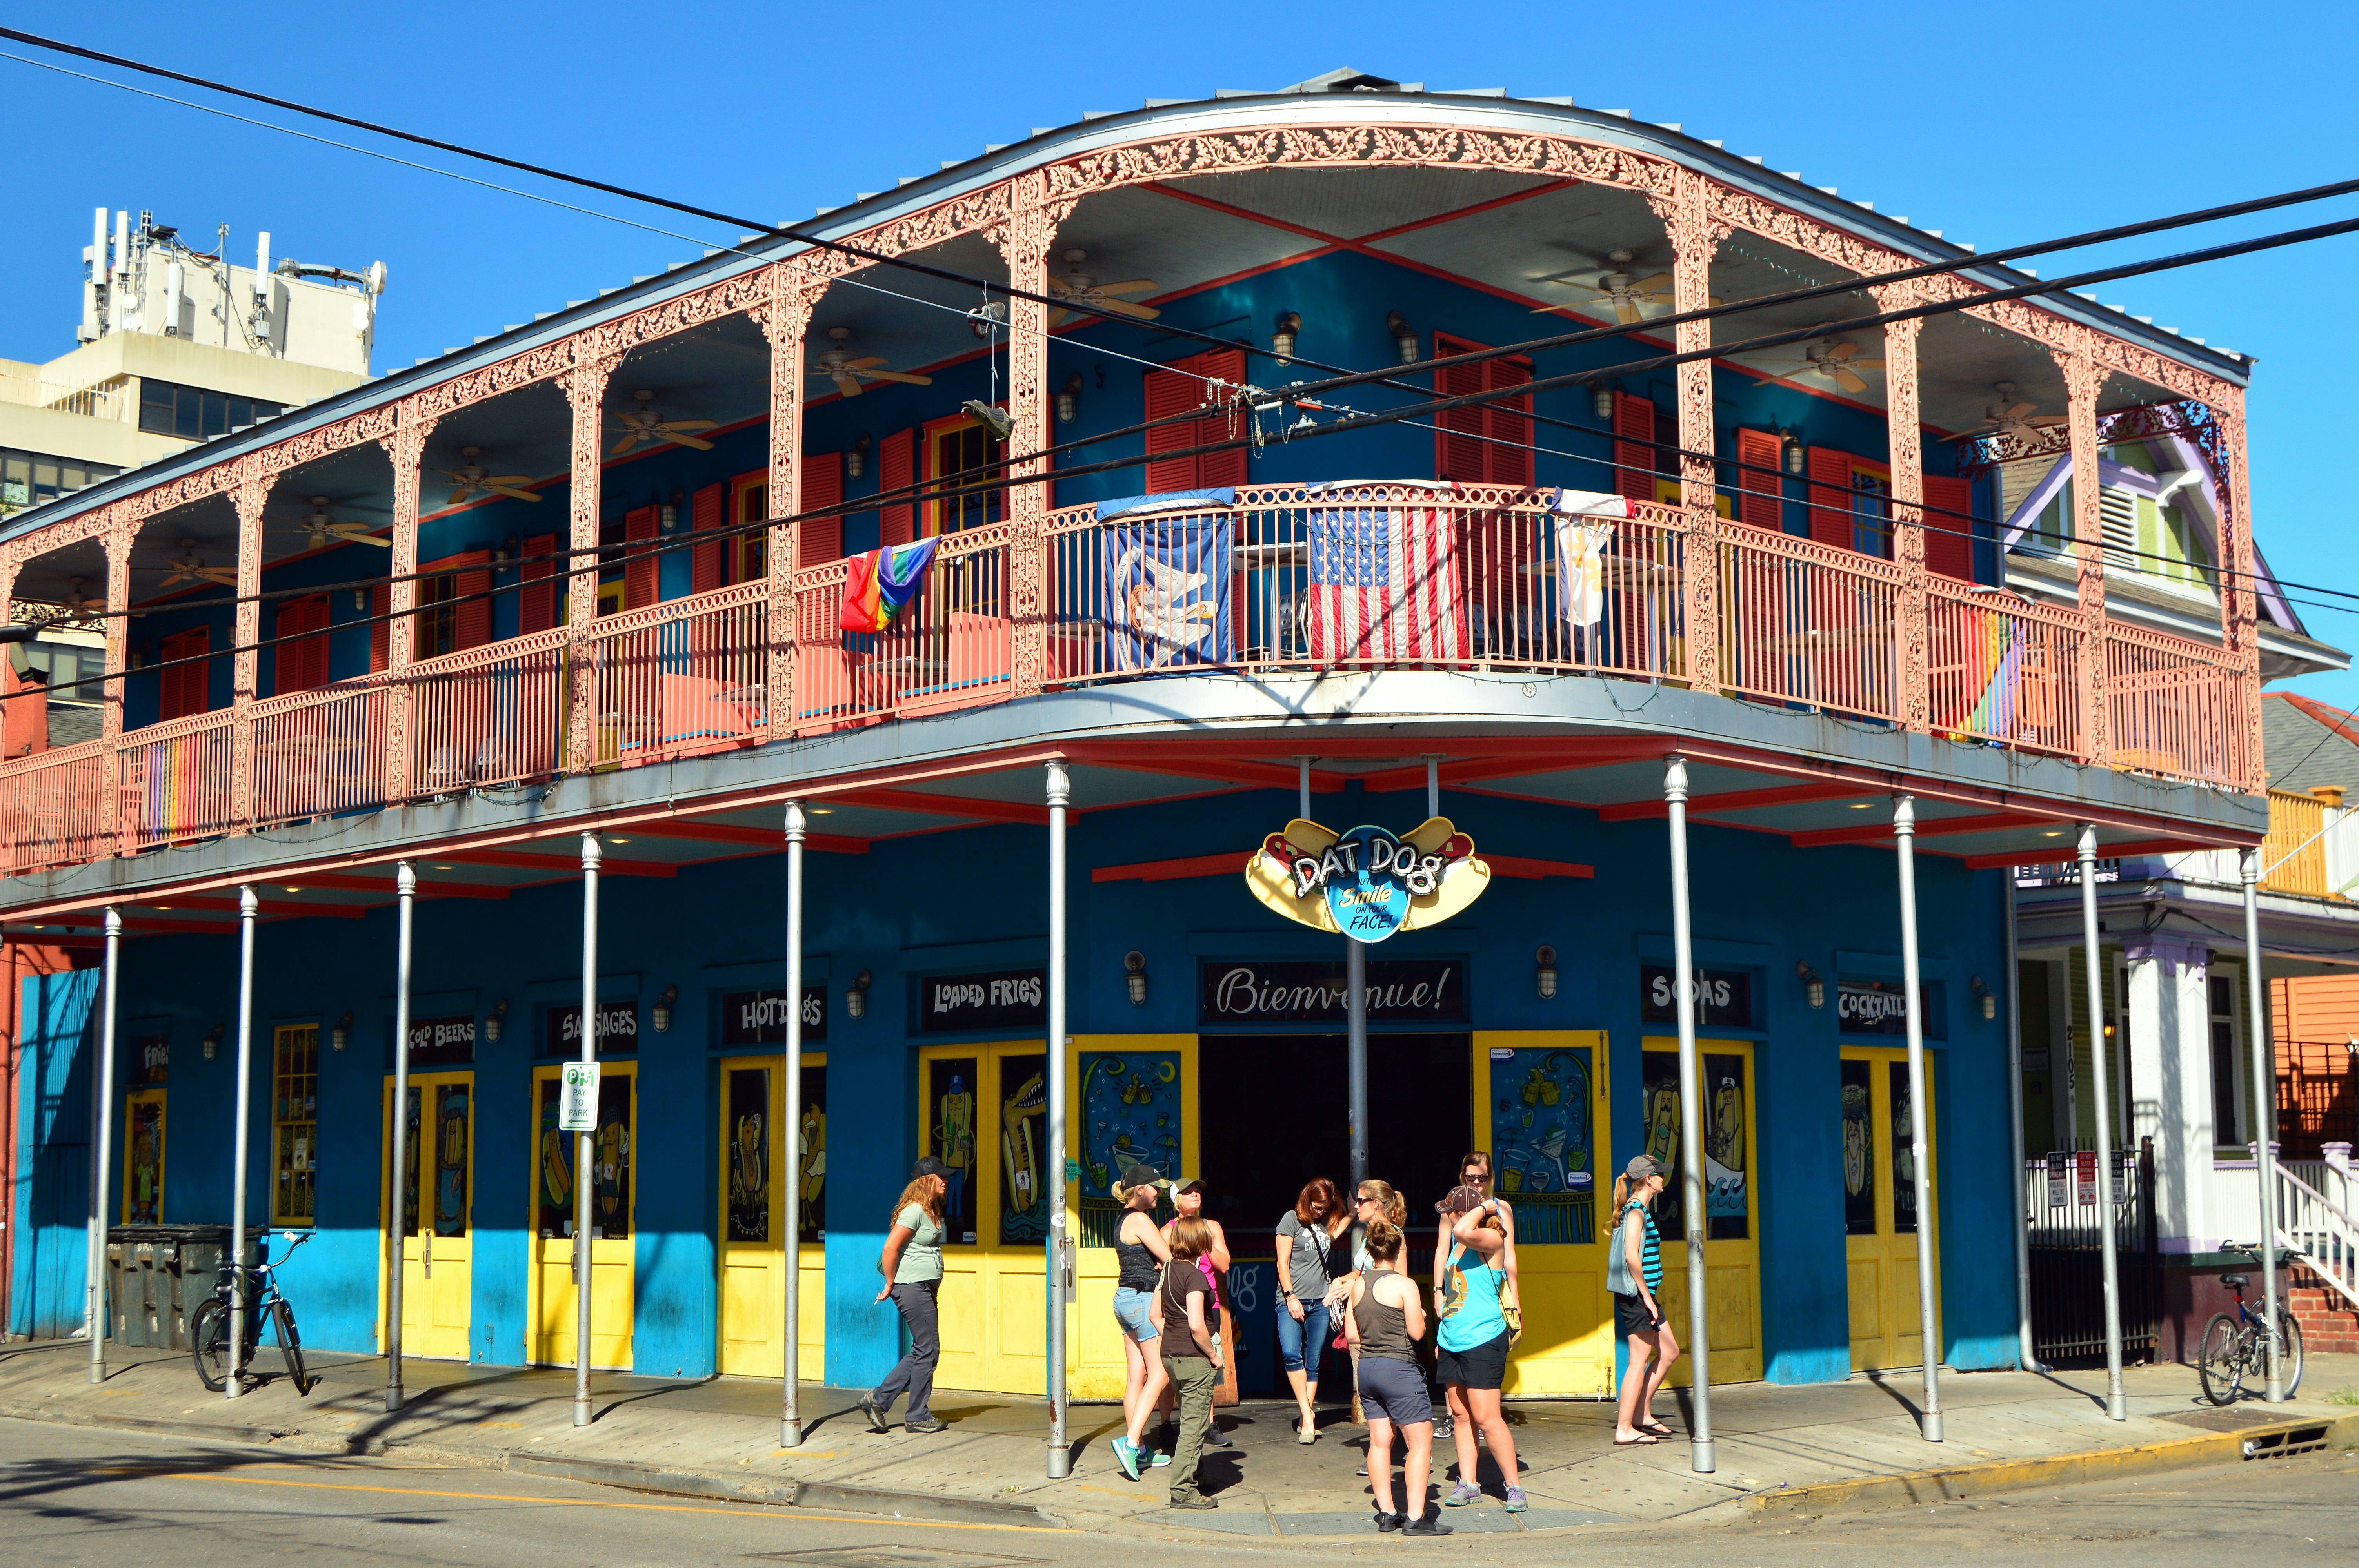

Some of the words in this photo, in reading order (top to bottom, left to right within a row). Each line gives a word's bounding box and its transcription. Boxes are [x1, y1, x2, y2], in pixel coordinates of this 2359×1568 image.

[1118, 559, 1128, 580] UNION
[1292, 840, 1361, 897] DAT
[1339, 885, 1392, 907] Smile
[1350, 914, 1393, 930] FACE!
[934, 984, 985, 1012] LOADED
[1839, 993, 1907, 1018] COCKTAIL
[409, 1026, 431, 1049] COLD
[435, 1023, 475, 1047] BEERS
[563, 1011, 636, 1040] SASAGES
